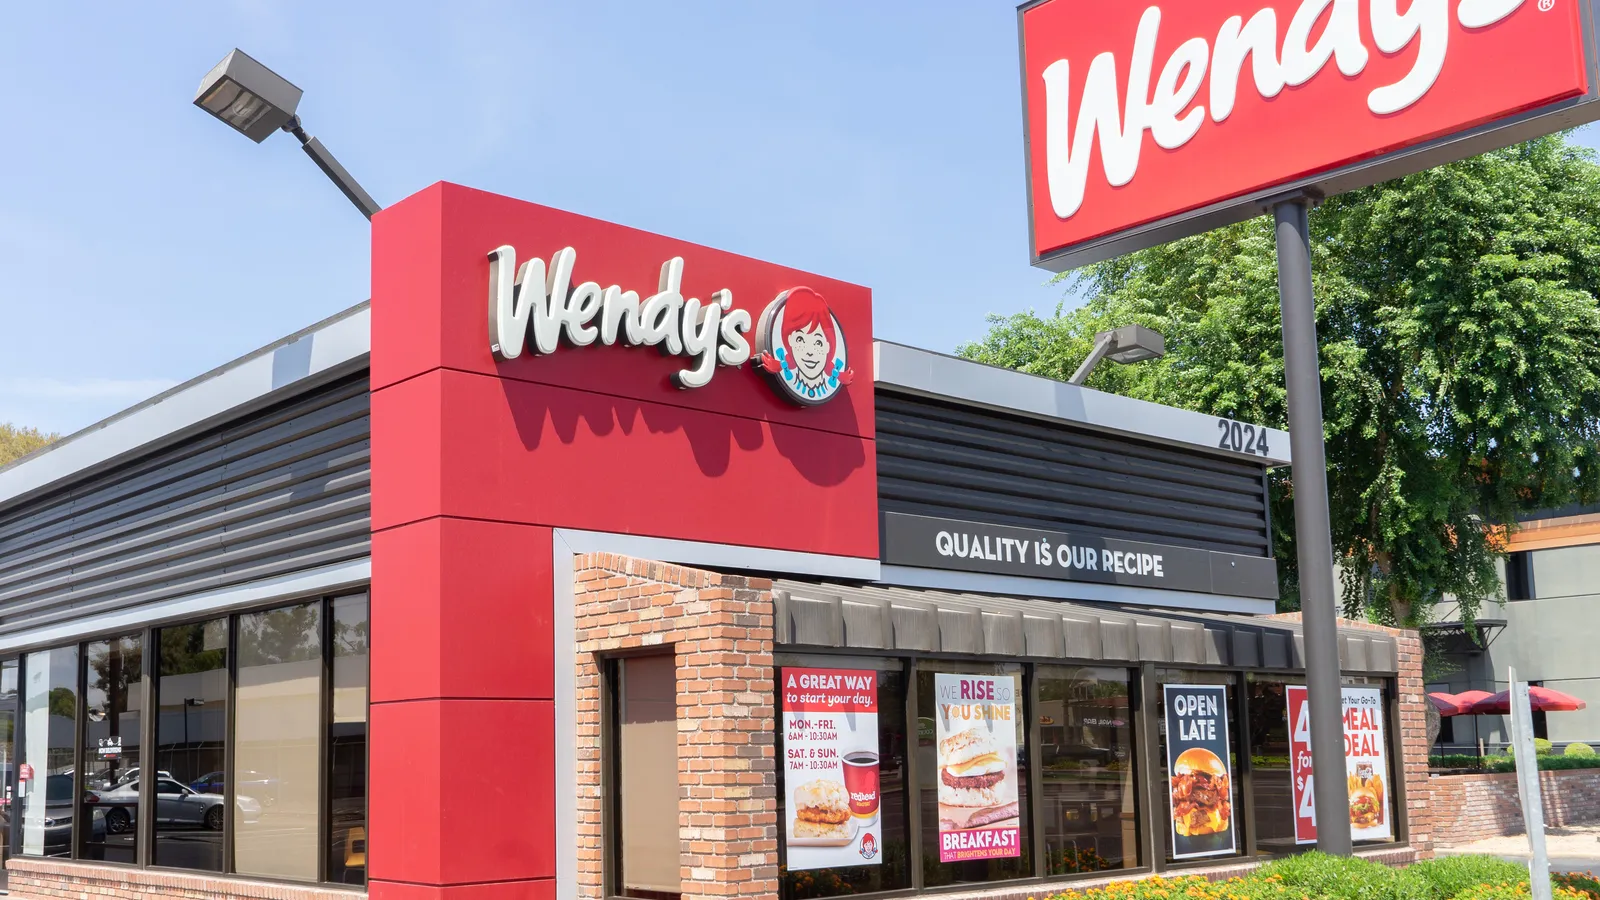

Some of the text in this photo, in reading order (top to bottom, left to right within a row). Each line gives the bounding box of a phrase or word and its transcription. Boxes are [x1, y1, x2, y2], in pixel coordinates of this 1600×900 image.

[488, 245, 752, 389] Wendy's
[1218, 419, 1269, 456] 2024
[935, 531, 1164, 577] QUALITY IS OUR RECIPE
[787, 674, 873, 690] A GREAT WAY
[940, 685, 957, 700] WE
[960, 680, 995, 700] RISE
[997, 687, 1011, 701] SO
[787, 692, 873, 707] to start your day.
[1174, 694, 1218, 716] OPEN
[1348, 696, 1360, 705] Your
[1360, 696, 1377, 705] Go-To
[974, 705, 1011, 721] SHINE
[789, 720, 836, 730] MON.-FRI.
[1179, 719, 1217, 741] LATE
[788, 732, 804, 741] 6AM
[809, 732, 838, 741] 10:30AM
[787, 749, 839, 759] SAT. & SUN.
[789, 761, 804, 770] 7AM
[810, 761, 838, 770] 10:30AM
[943, 829, 1017, 851] BREAKFAST
[943, 848, 1016, 860] THAT BRIGHTENS YOUR DAY
